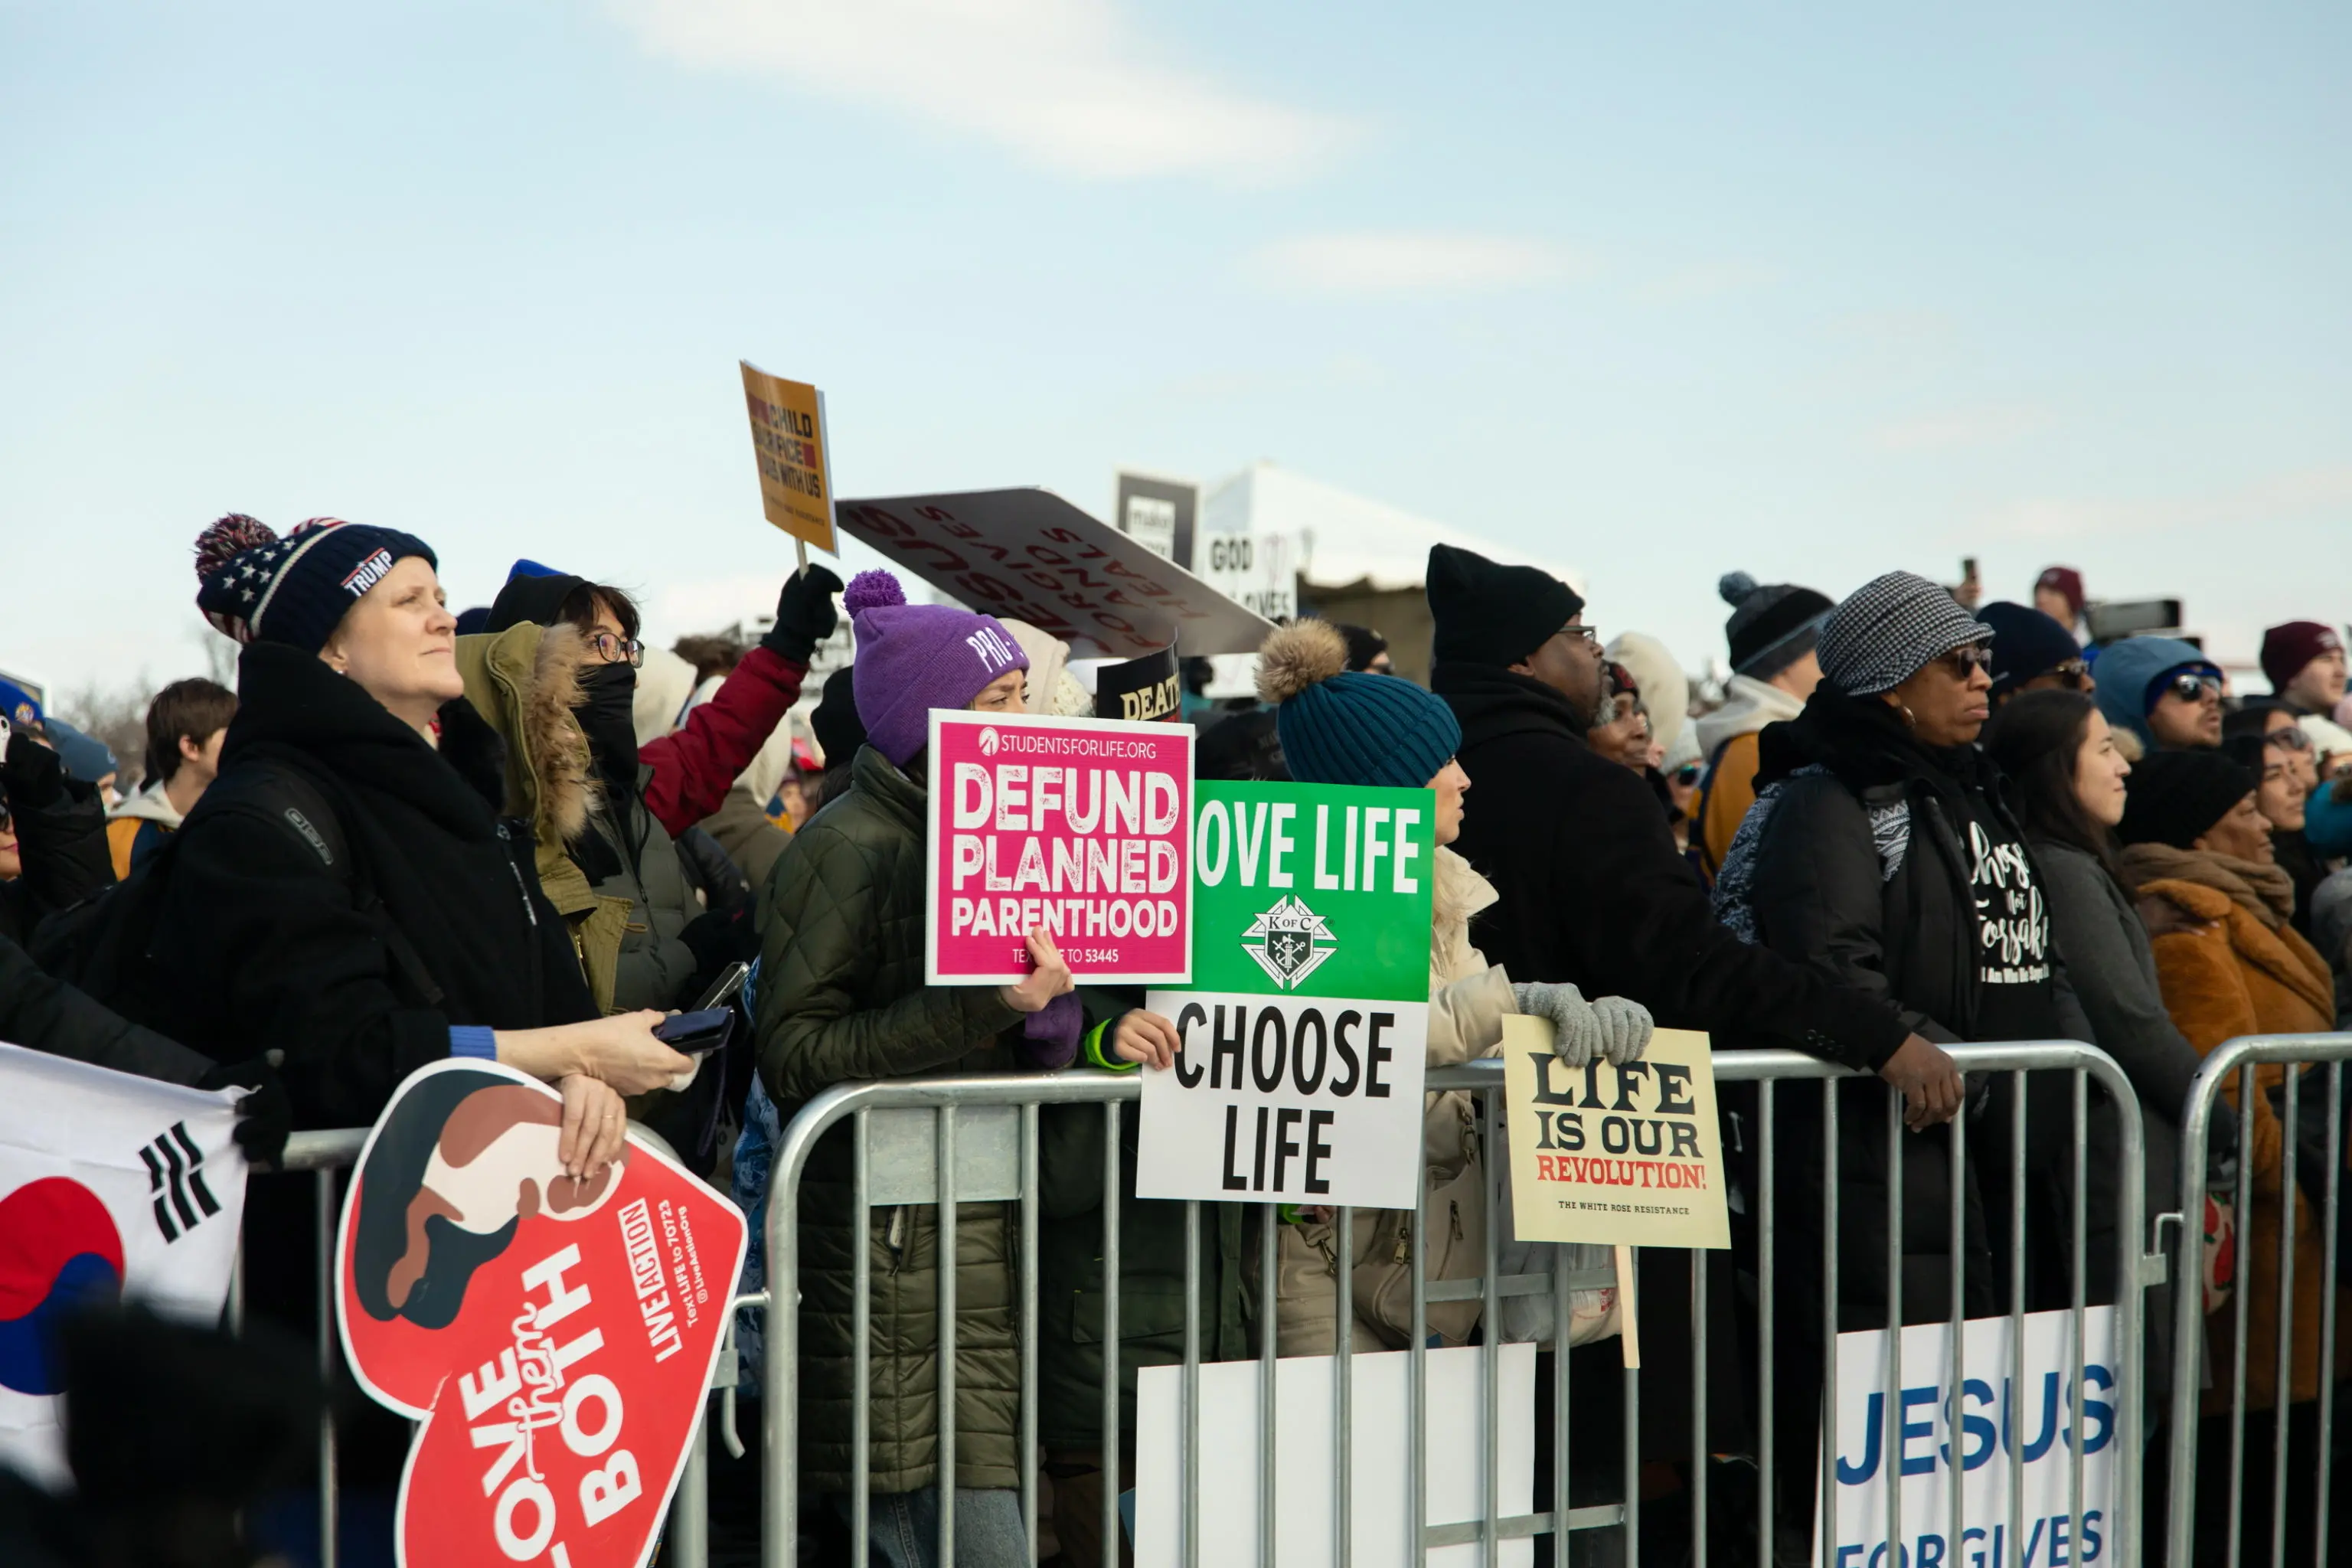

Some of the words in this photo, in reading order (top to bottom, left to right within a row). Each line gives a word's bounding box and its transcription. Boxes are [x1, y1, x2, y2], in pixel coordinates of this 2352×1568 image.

[769, 403, 813, 439] CHILD
[805, 471, 822, 498] US
[345, 550, 394, 597] TRUMP
[1210, 538, 1253, 571] GOD
[954, 763, 1180, 835] DEFUND
[952, 834, 1179, 893] PLANNED
[1196, 799, 1296, 888] OVE
[1314, 804, 1420, 893] LIFE
[952, 897, 1178, 938] PARENTHOOD
[1269, 916, 1280, 929] K
[1282, 919, 1298, 927] OF
[1300, 917, 1312, 931] C
[1067, 949, 1082, 962] TO
[1085, 949, 1119, 962] 53445
[1174, 1001, 1394, 1097] CHOOSE
[1527, 1052, 1695, 1115] LIFE
[1222, 1105, 1334, 1194] LIFE
[1534, 1111, 1586, 1151] IS
[1602, 1116, 1704, 1158] OUR
[1536, 1155, 1707, 1189] REVOLUTION!
[658, 1199, 679, 1247] 70723
[1559, 1200, 1576, 1209] THE
[1579, 1202, 1608, 1211] WHITE
[1611, 1204, 1632, 1212] ROSE
[1635, 1206, 1690, 1215] RESISTANCE
[621, 1200, 663, 1294] ACTION
[672, 1246, 684, 1263] to
[673, 1263, 691, 1295] LIFE
[640, 1289, 683, 1364] LIVE
[682, 1294, 698, 1328] Text
[508, 1302, 566, 1482] them
[521, 1243, 643, 1528] BOTH
[1835, 1364, 2115, 1485] JESUS
[459, 1347, 572, 1568] OVE
